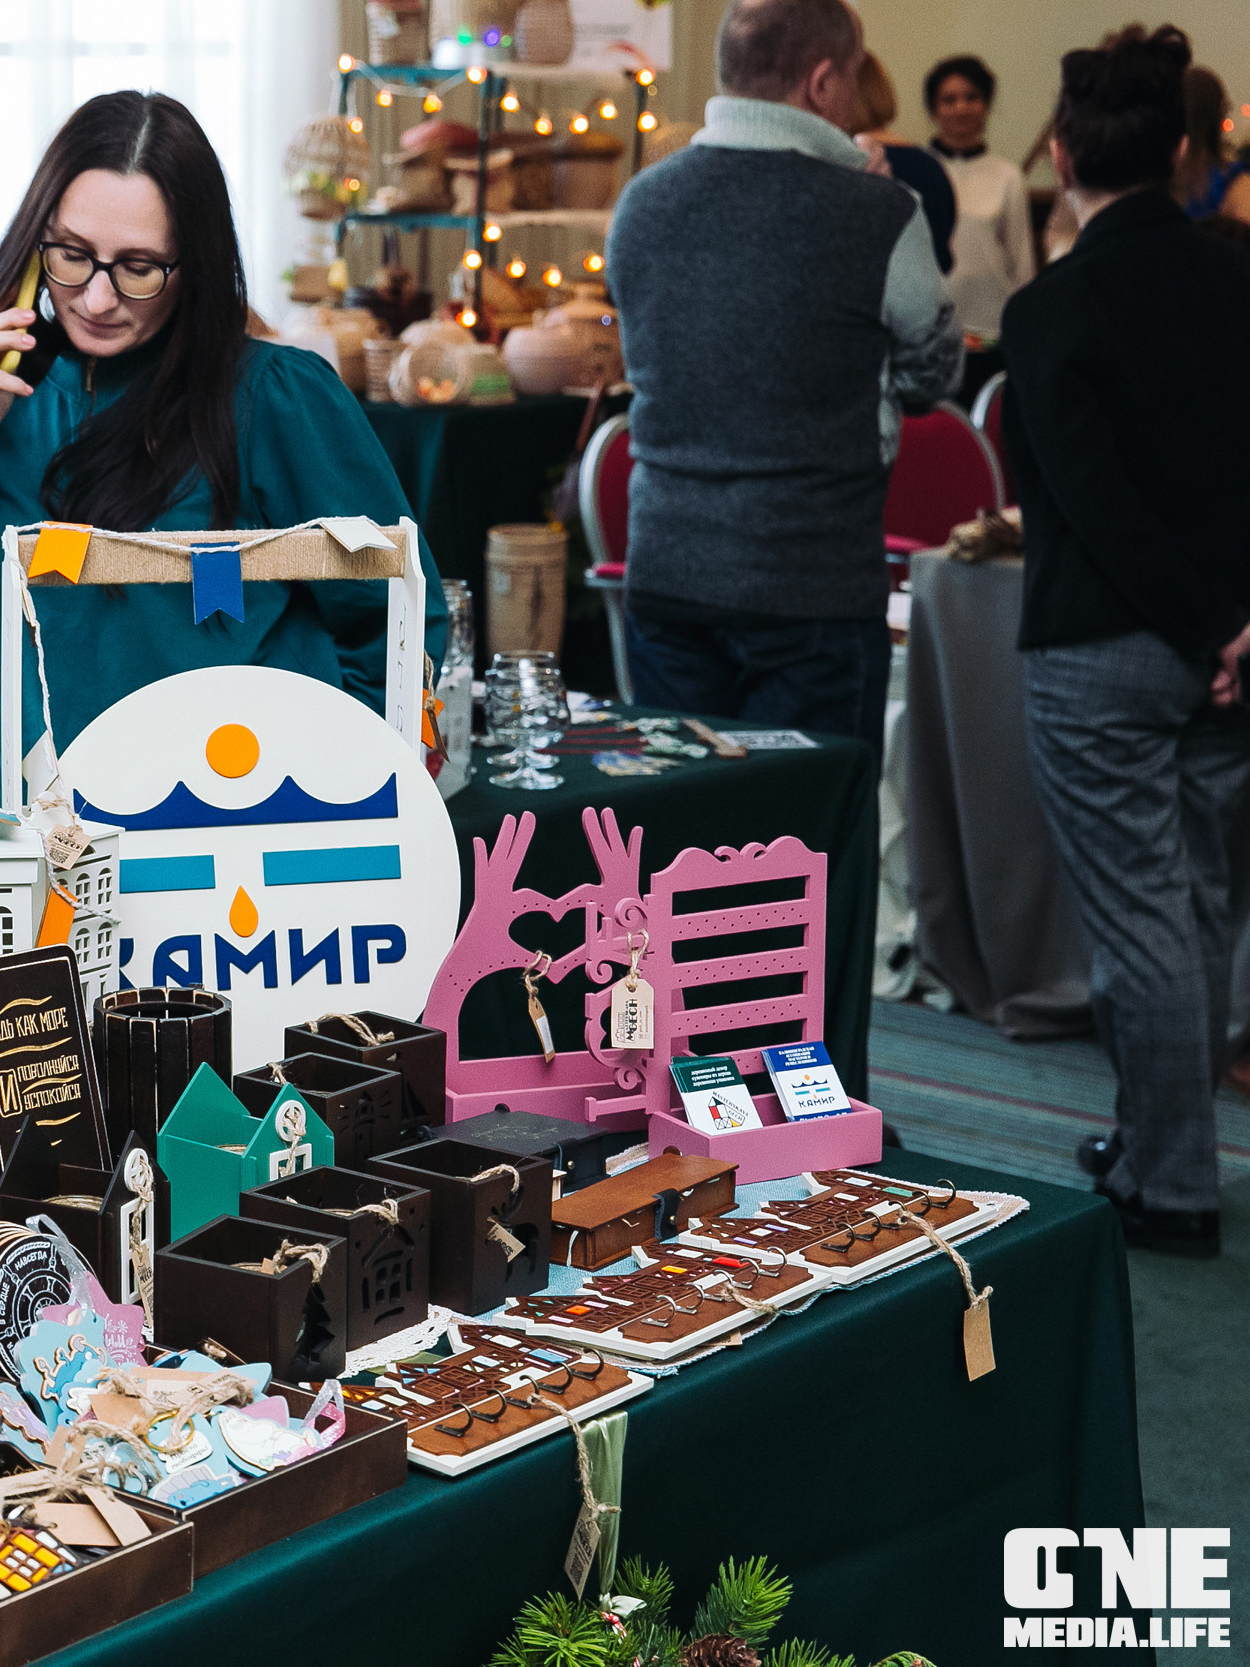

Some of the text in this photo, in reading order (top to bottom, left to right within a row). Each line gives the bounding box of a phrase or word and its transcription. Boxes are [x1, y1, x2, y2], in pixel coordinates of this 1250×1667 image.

[15, 1013, 40, 1038] КАК
[39, 1006, 69, 1033] МОРЕ
[16, 1054, 80, 1083] ПОВОЛНУЙСЯ
[23, 1083, 82, 1111] УСПОКОЙСЯ
[798, 1096, 836, 1108] КАМИР
[14, 1250, 48, 1271] НАВСЕГДА
